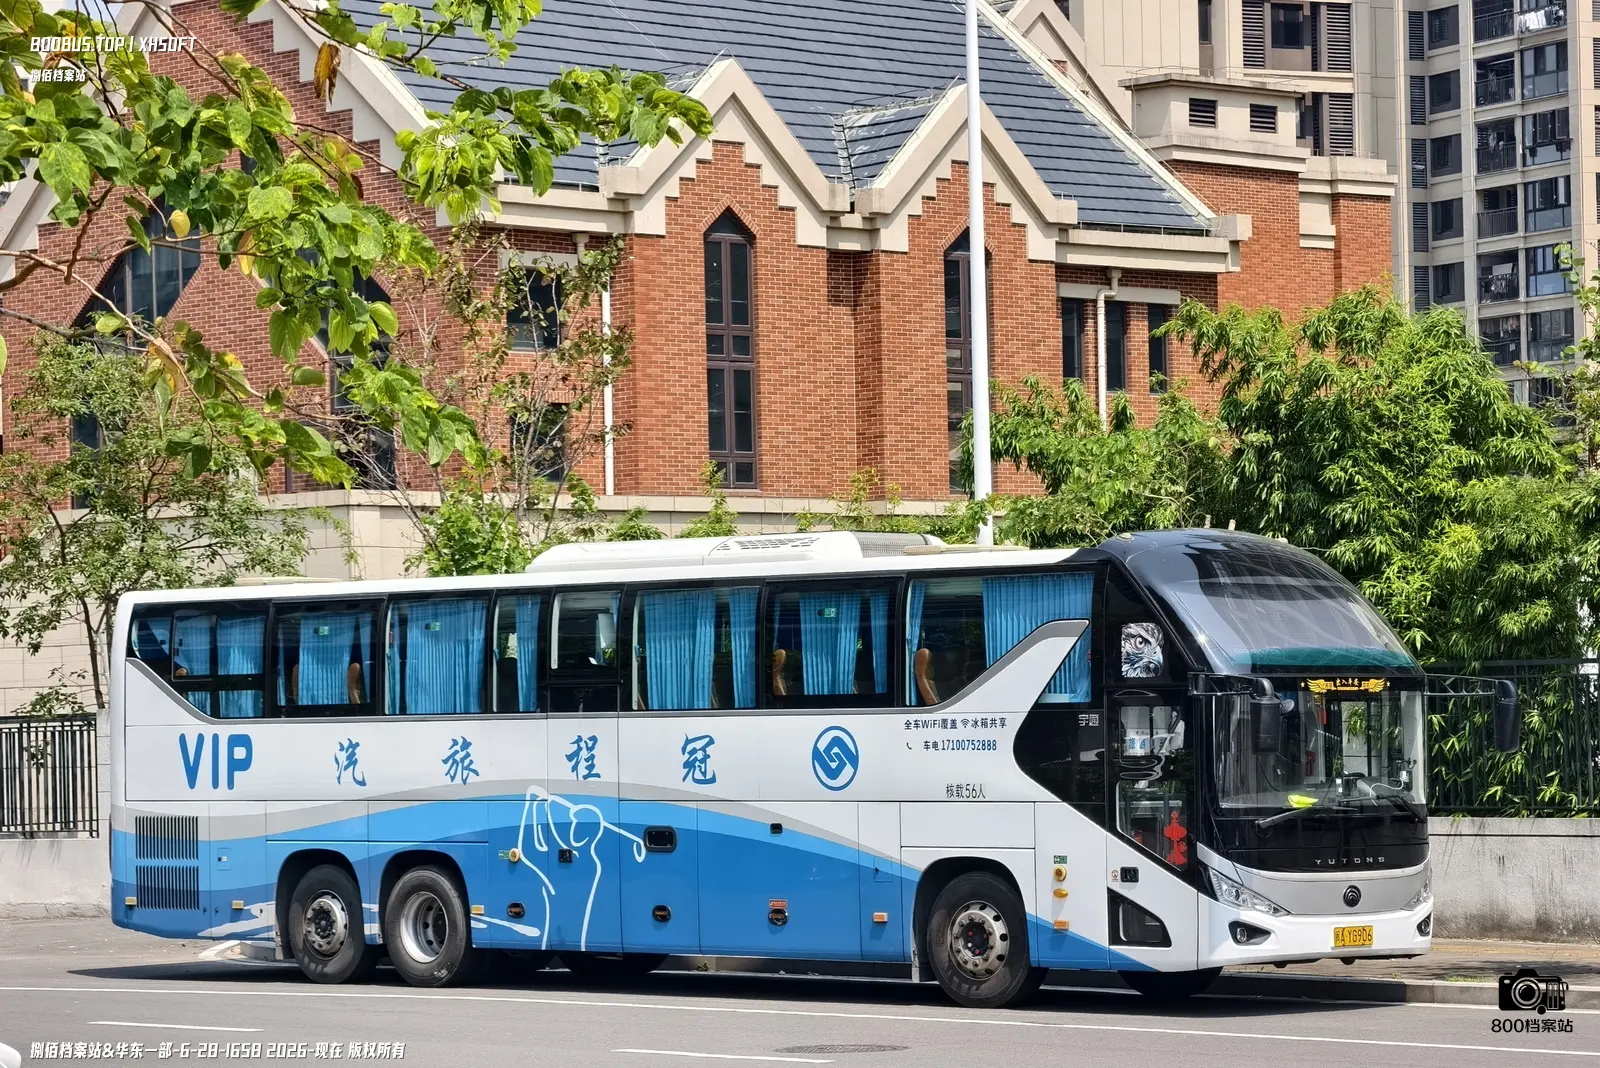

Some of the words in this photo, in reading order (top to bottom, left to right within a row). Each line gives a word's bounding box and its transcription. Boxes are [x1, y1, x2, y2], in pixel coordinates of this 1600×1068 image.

[970, 717, 1008, 729] 冰箱共享
[178, 732, 254, 791] VIP
[945, 783, 986, 799] 核载56人
[1314, 856, 1385, 866] YUTONG
